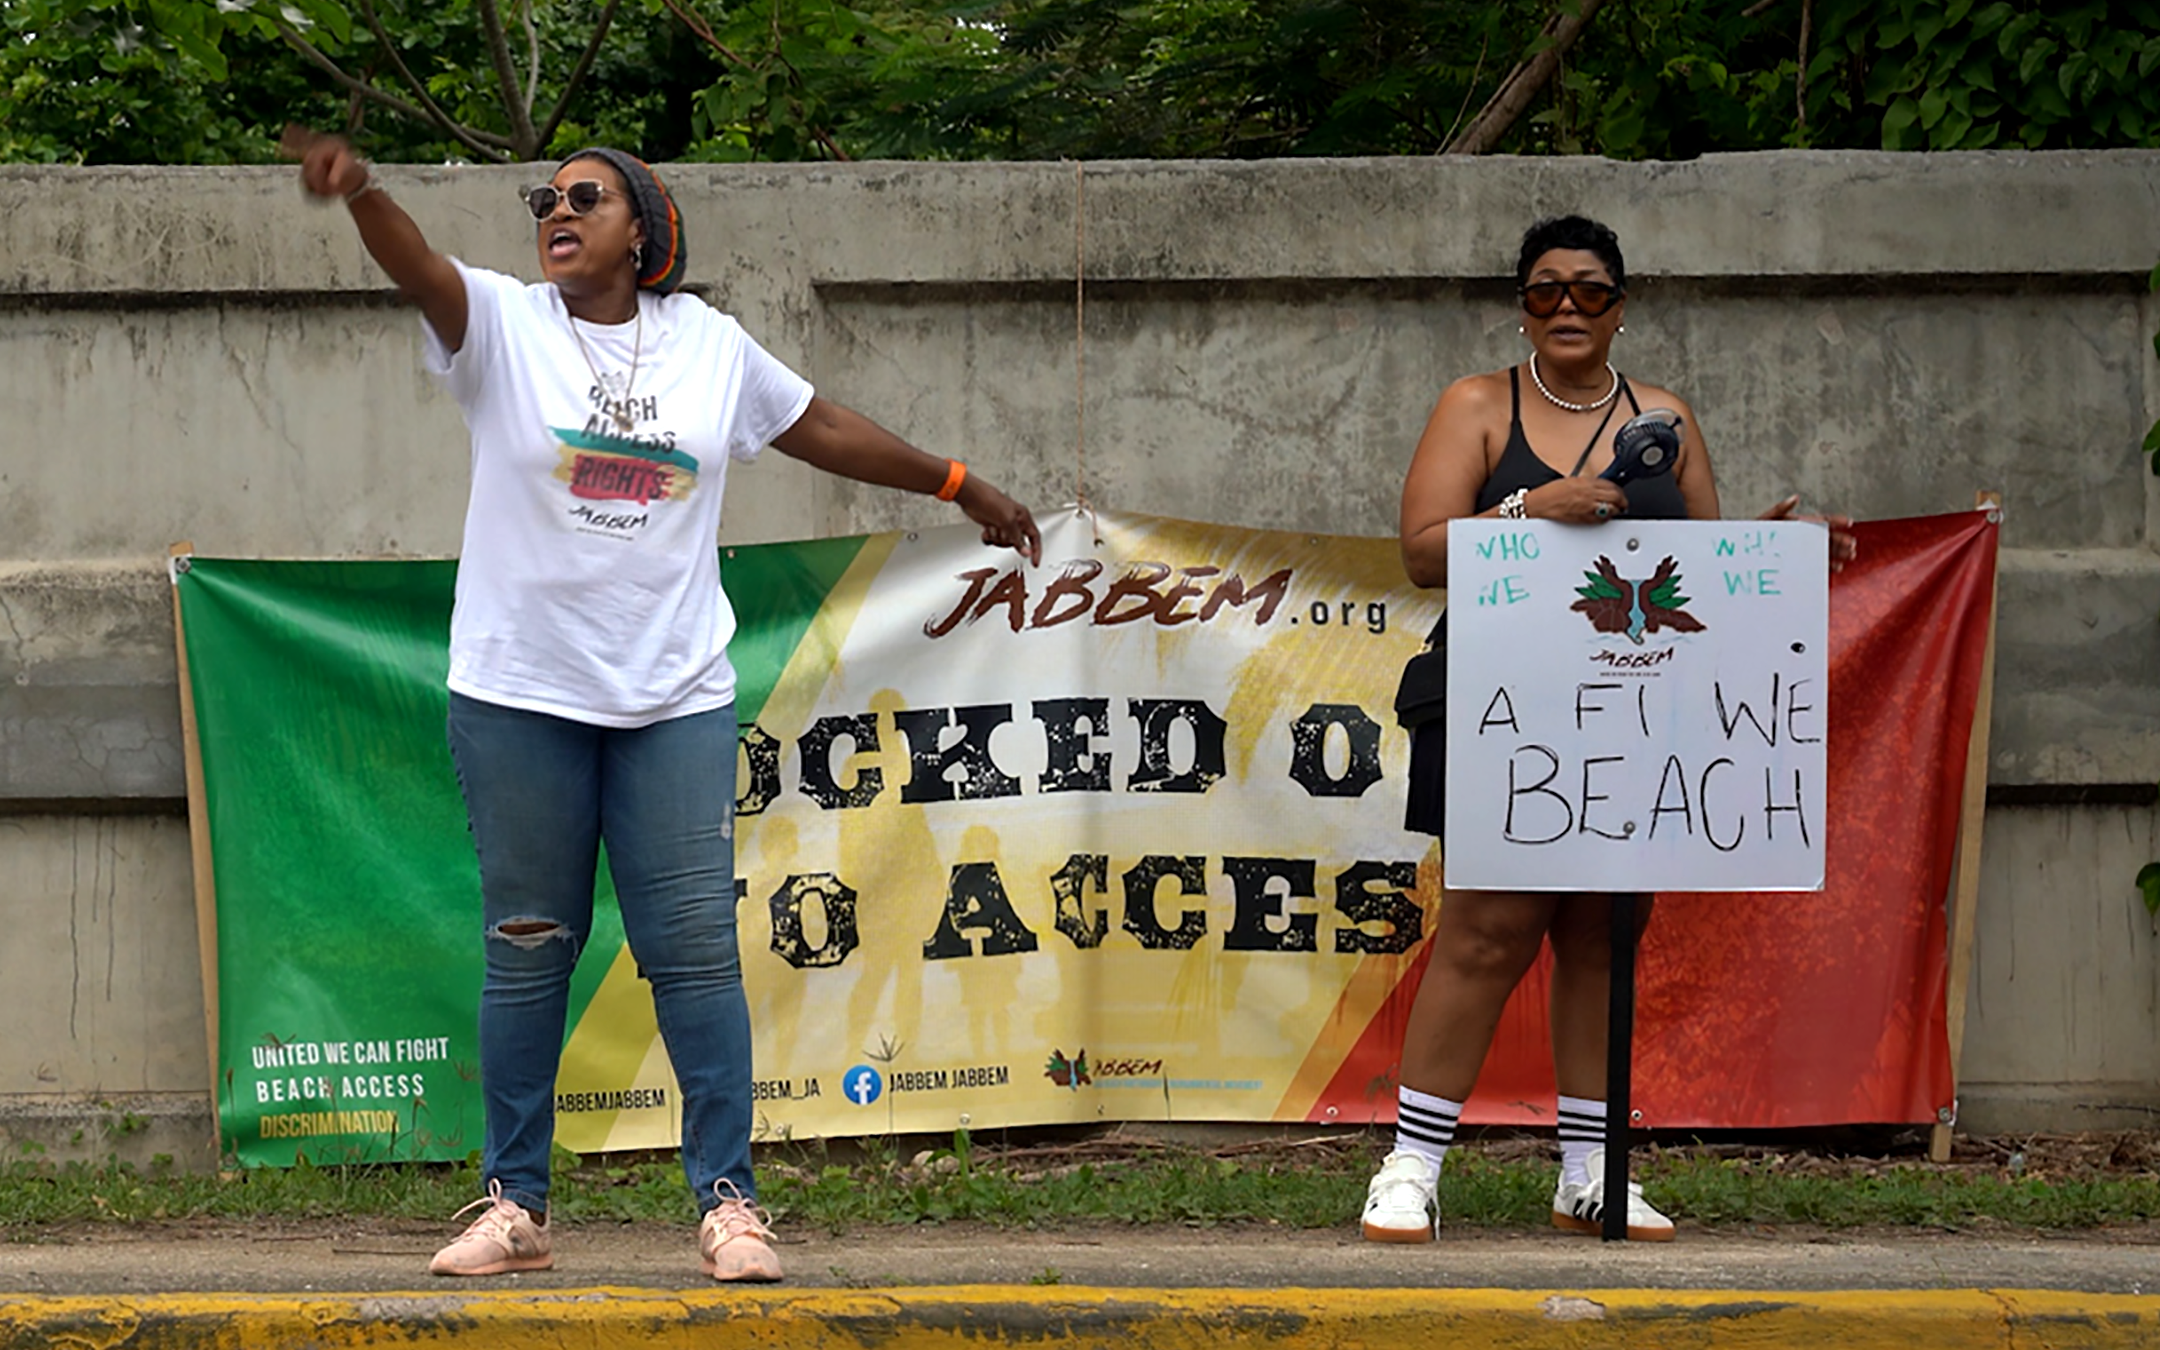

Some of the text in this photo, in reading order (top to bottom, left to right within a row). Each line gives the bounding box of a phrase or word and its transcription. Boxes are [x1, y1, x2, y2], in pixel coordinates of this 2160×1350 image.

[576, 459, 664, 500] RIGHTS
[568, 505, 648, 529] JABBEM
[1723, 569, 1782, 595] WE
[1589, 647, 1674, 668] JABBEM
[1479, 687, 1519, 735] A
[1713, 673, 1821, 747] WE
[1503, 745, 1810, 850] BEACH
[252, 1037, 449, 1069] UNITED WE CAN FIGHT
[256, 1073, 425, 1102] BEACH ACCESS
[890, 1066, 1009, 1092] JABBEM JABBEM
[259, 1110, 399, 1138] DISCRIMINATION
